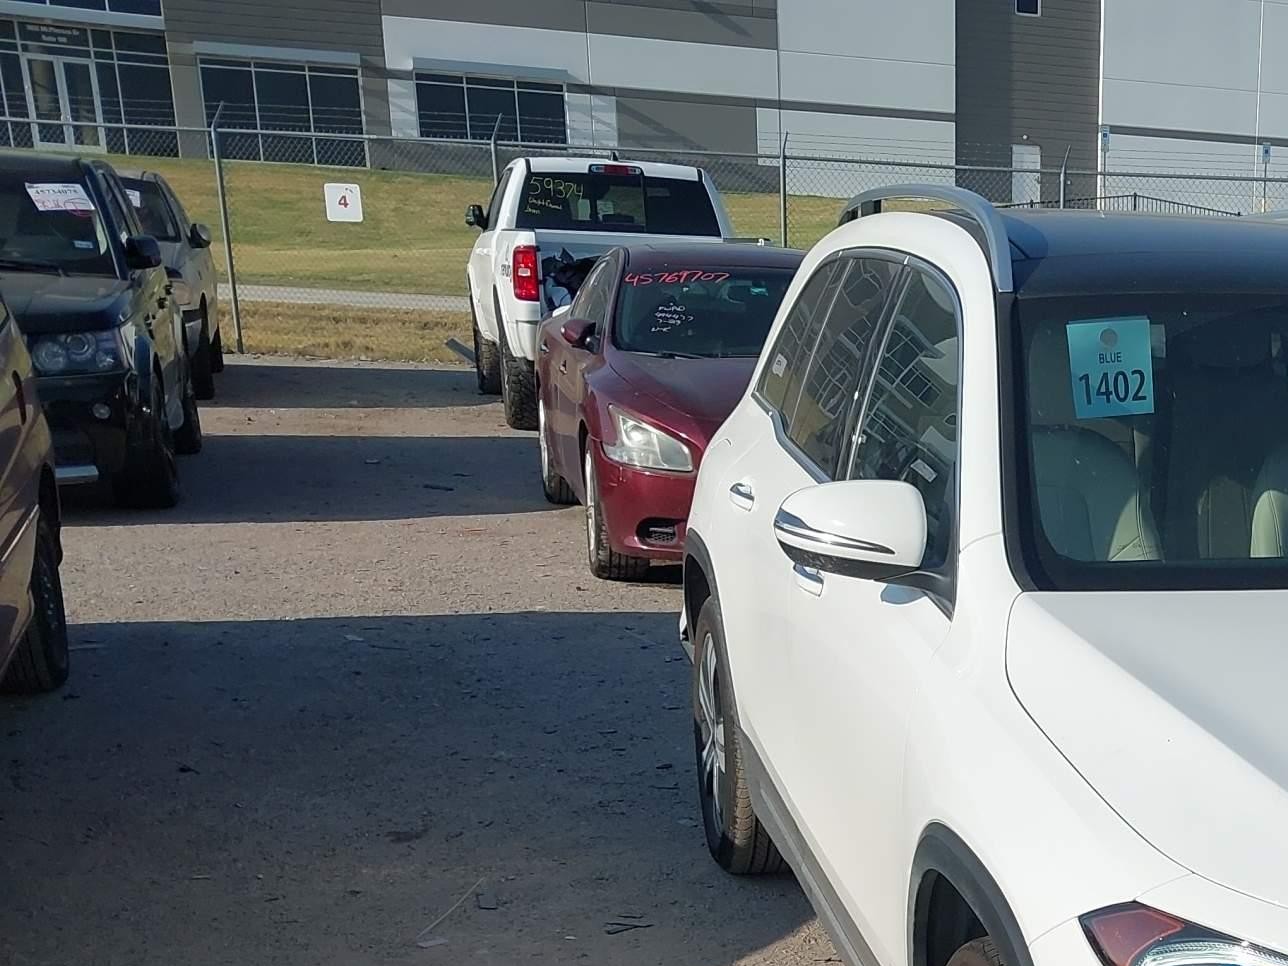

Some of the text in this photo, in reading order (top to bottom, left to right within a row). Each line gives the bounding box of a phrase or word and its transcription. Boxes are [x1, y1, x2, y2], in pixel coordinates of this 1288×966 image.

[529, 177, 584, 200] 59374
[338, 195, 350, 208] 4
[1098, 352, 1122, 364] BLUE
[1078, 369, 1147, 406] 1402
